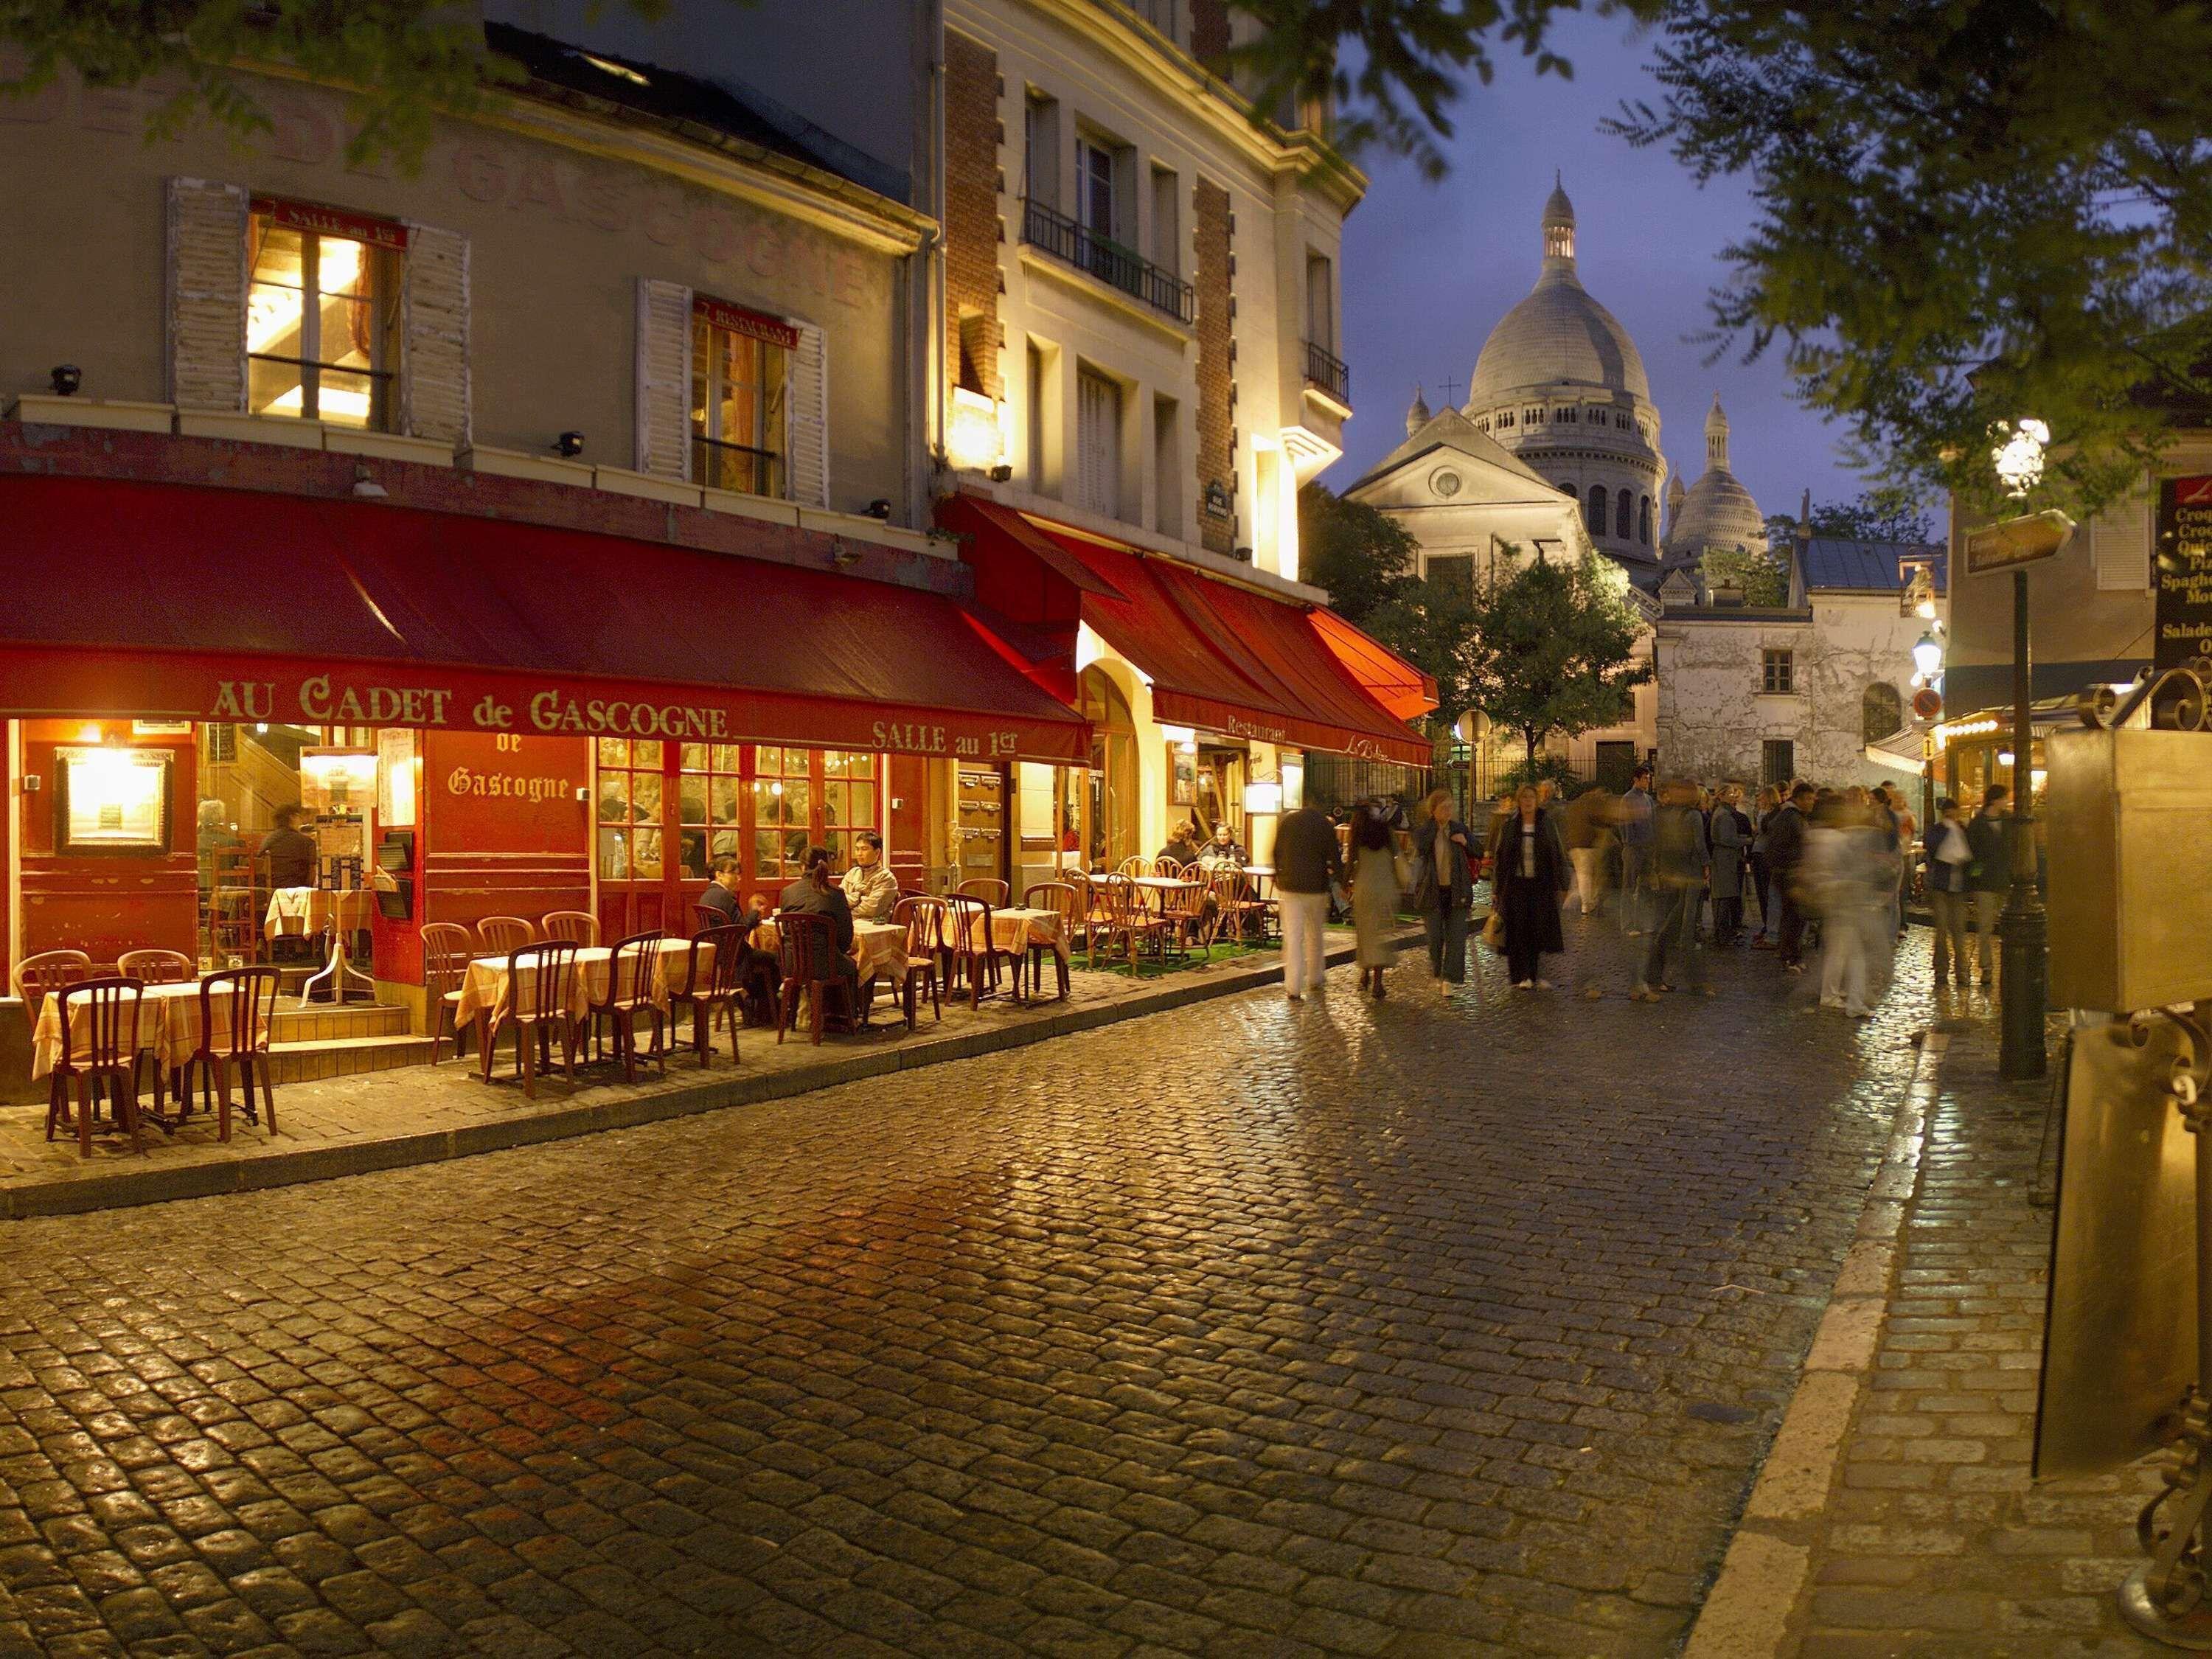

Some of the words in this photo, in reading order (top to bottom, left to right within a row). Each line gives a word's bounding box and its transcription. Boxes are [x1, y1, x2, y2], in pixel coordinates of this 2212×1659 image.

[209, 681, 275, 719] AU
[299, 667, 452, 724] CADET
[473, 695, 513, 728] de
[530, 689, 728, 737] GASCOGNE
[872, 721, 947, 752] SALLE
[956, 736, 979, 755] au
[988, 731, 1018, 757] 1er
[1228, 714, 1286, 742] Restaurant
[448, 766, 569, 803] Gascogne
